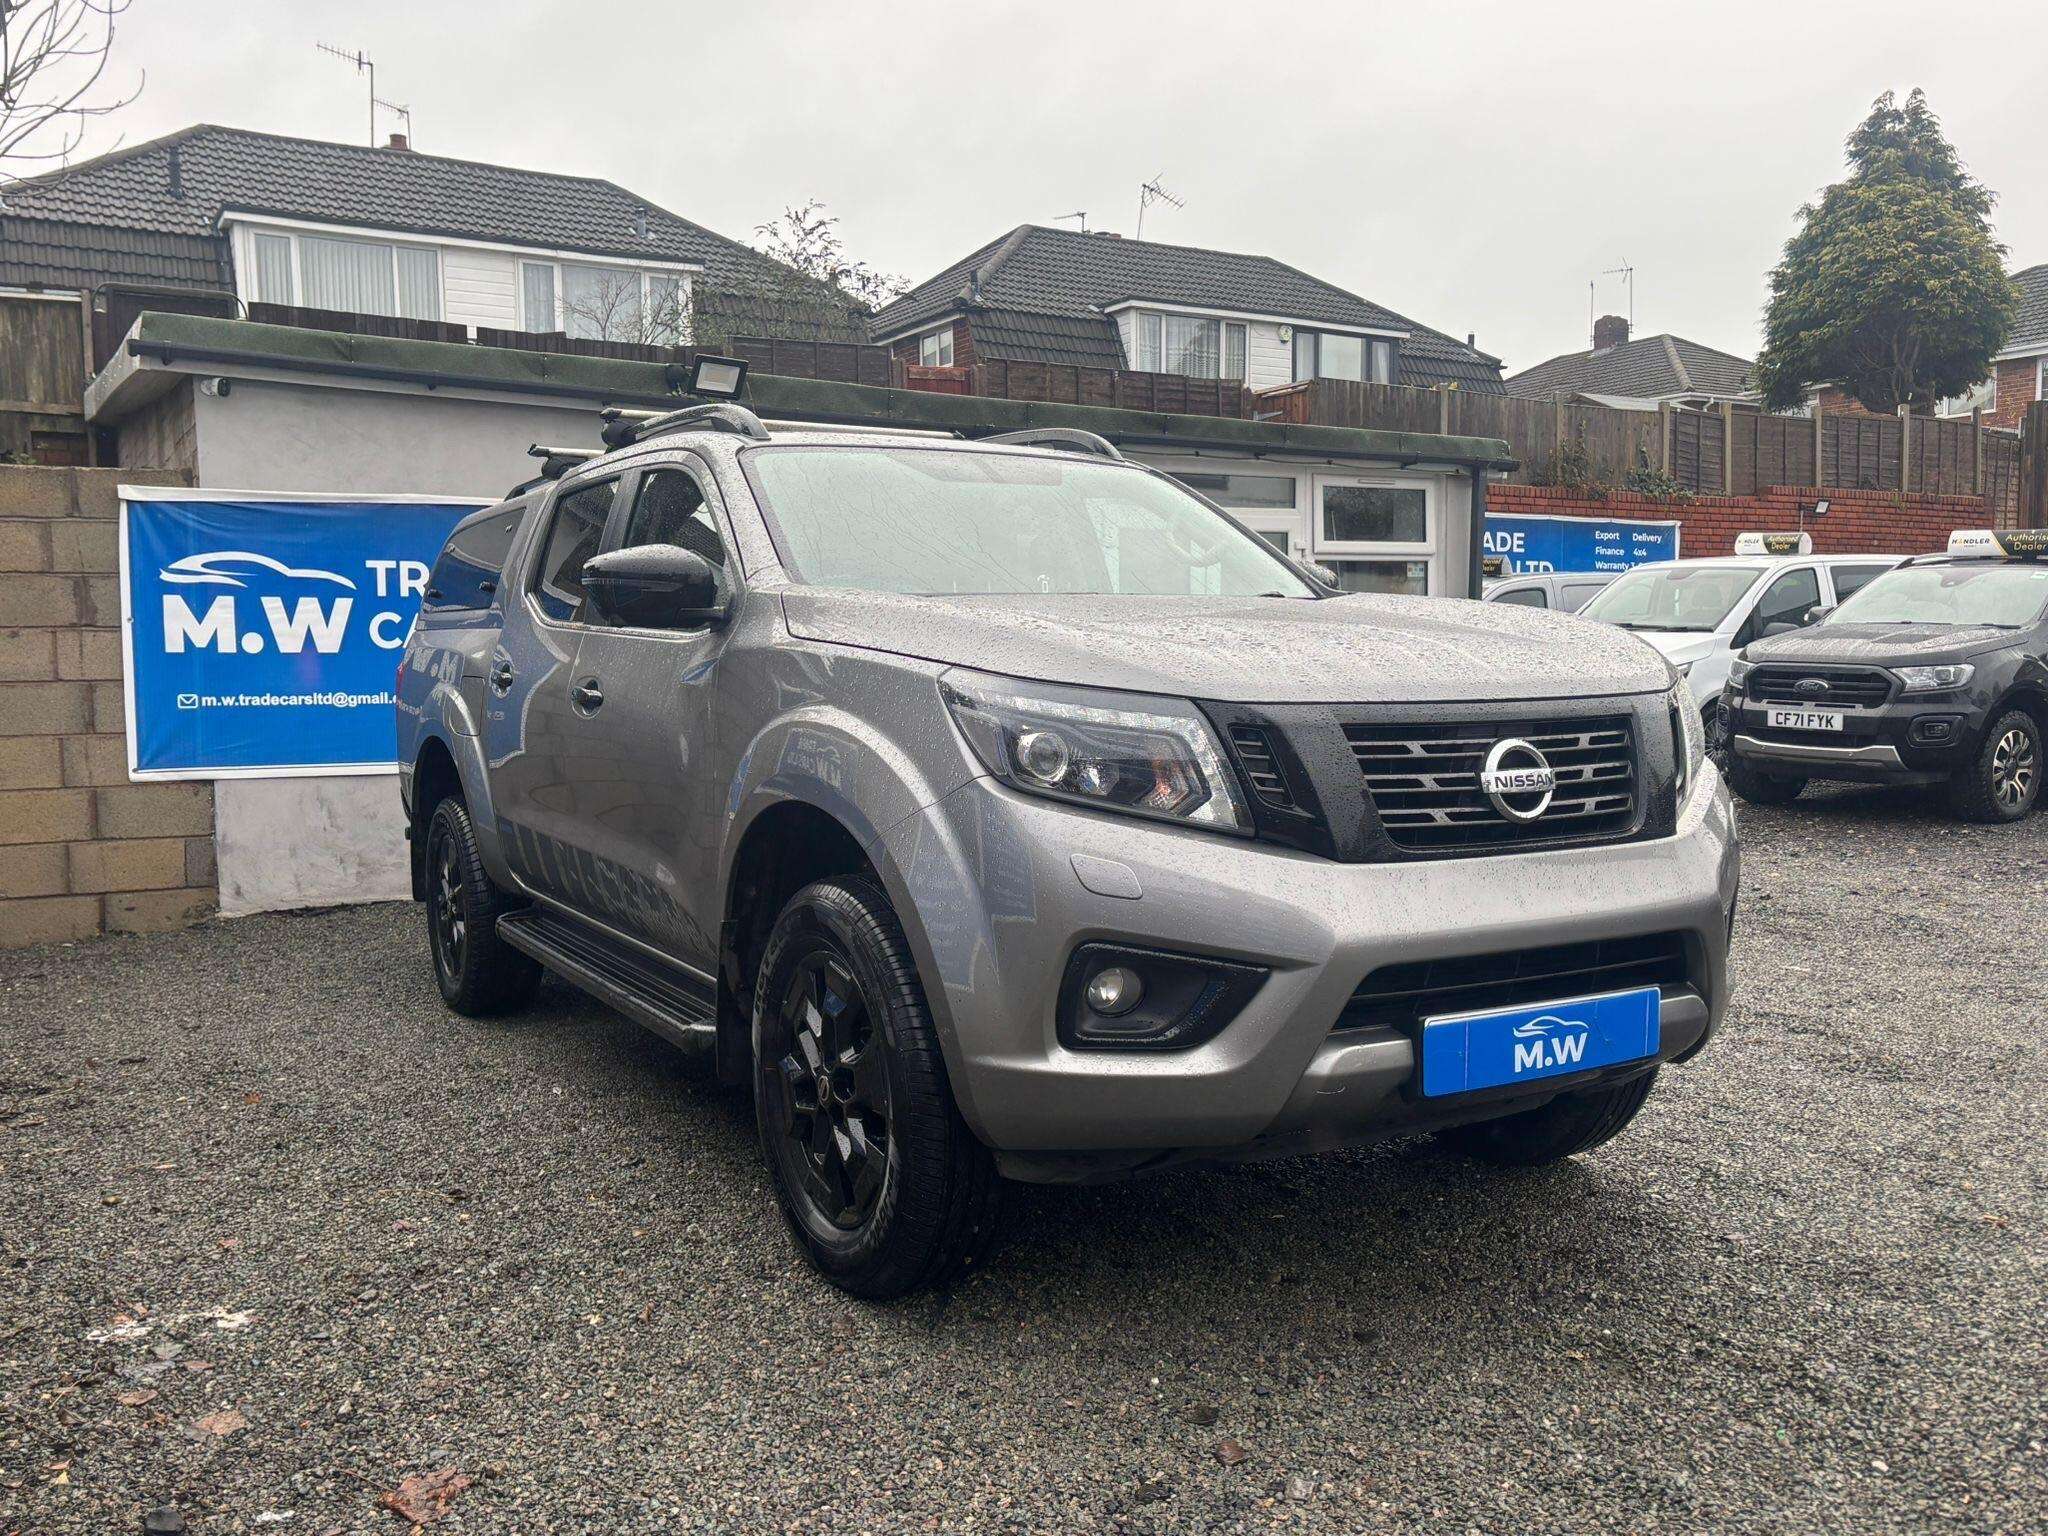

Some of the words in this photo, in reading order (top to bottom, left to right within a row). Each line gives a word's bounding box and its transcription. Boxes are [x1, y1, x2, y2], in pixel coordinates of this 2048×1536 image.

[1483, 531, 1525, 553] ADE
[1595, 530, 1620, 542] Export
[1632, 532, 1662, 544] Delivery
[1595, 546, 1625, 556] Finance
[1633, 547, 1647, 557] 4x4
[2013, 541, 2046, 551] Dealer
[1595, 560, 1629, 571] Warranty
[163, 594, 354, 654] M.W
[1775, 712, 1804, 727] CF71
[1807, 715, 1834, 728] FYK
[1494, 773, 1554, 789] NISSAN
[1514, 1032, 1588, 1073] M.W
